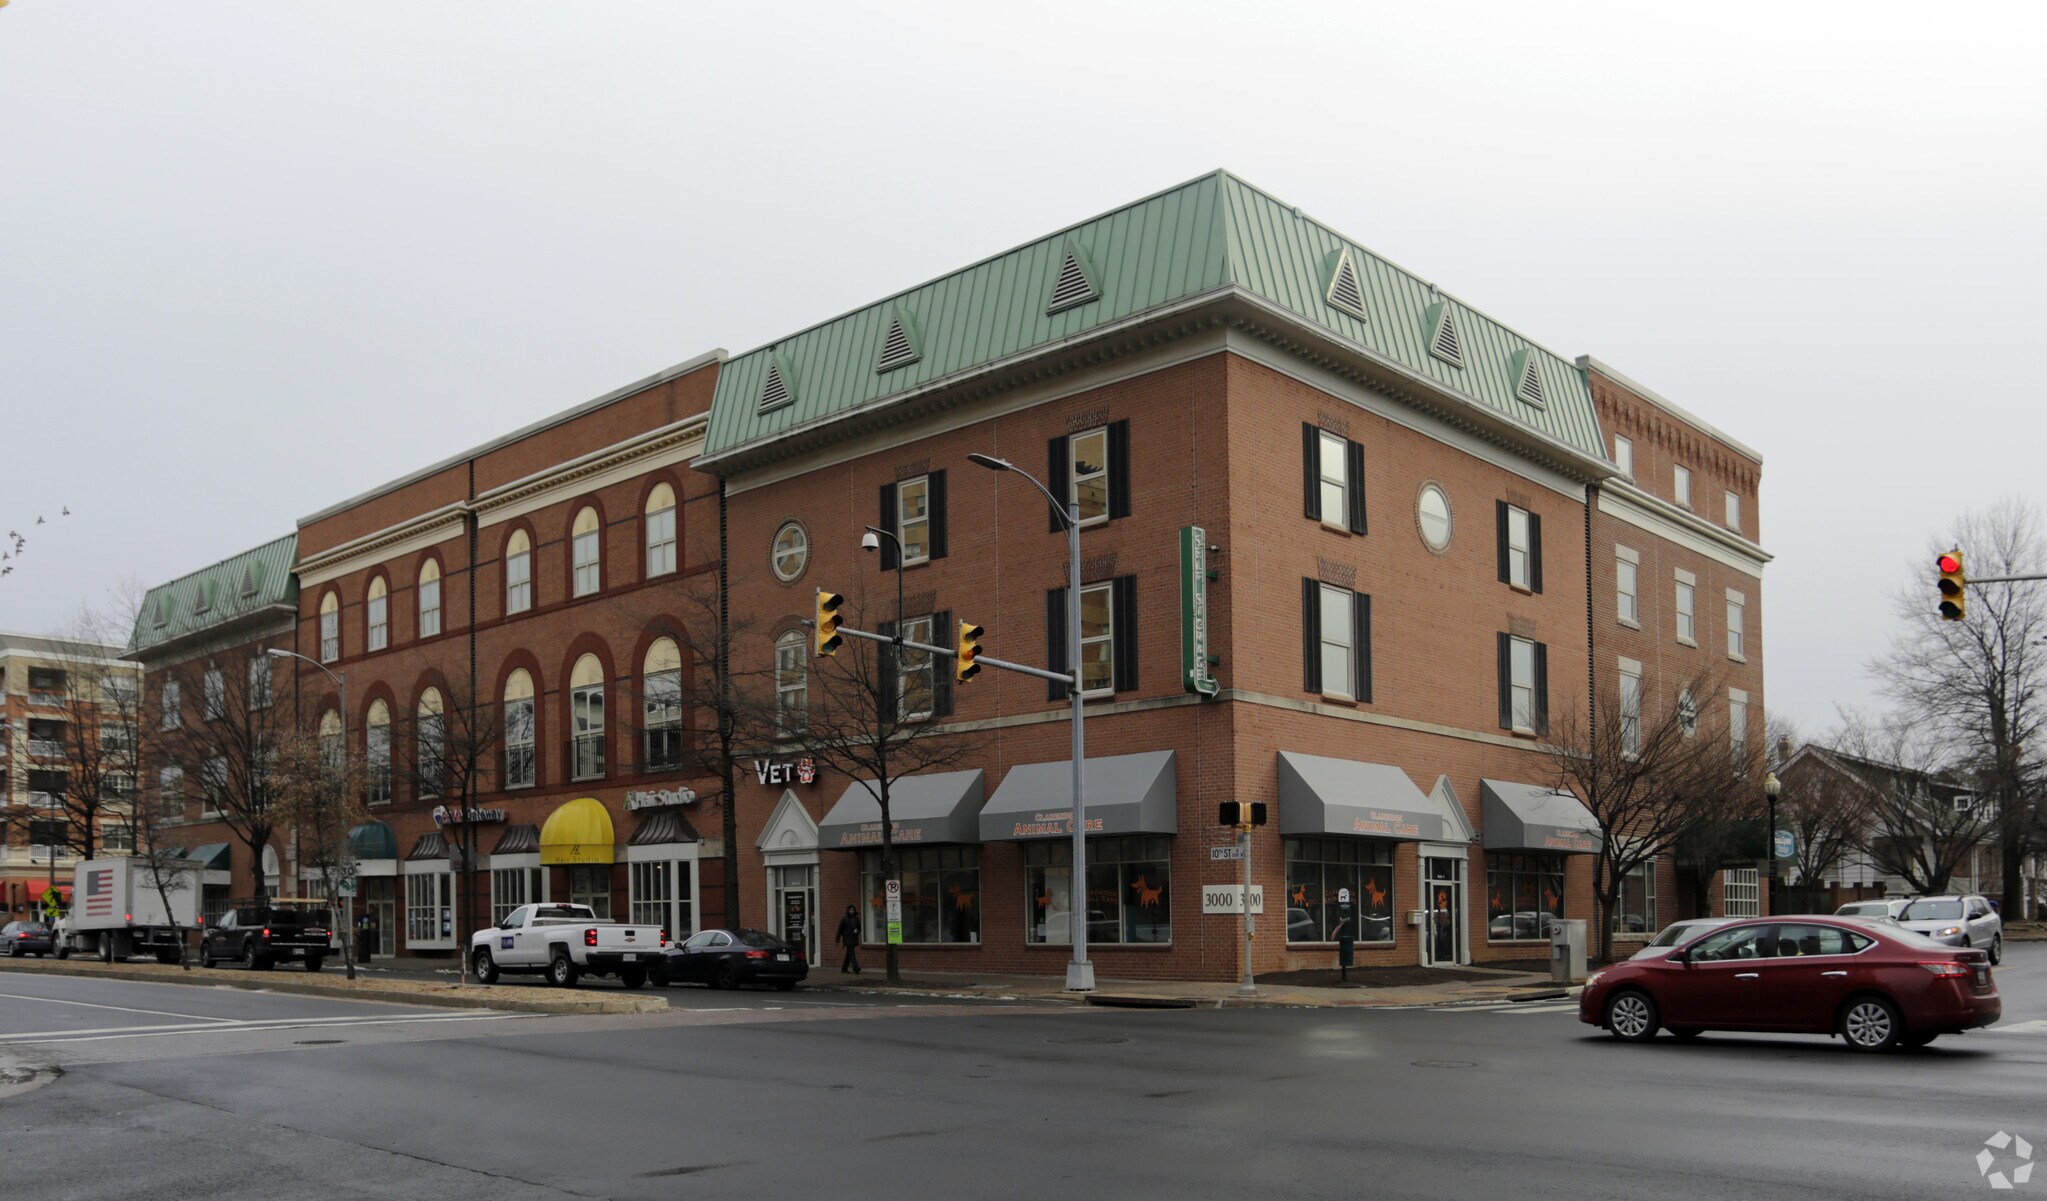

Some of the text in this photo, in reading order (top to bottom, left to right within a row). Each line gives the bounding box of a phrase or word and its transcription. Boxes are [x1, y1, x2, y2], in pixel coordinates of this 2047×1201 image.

[753, 759, 794, 784] VET
[1013, 818, 1103, 836] ANIMAL CRE
[1353, 817, 1419, 836] ANIMAL CARE
[841, 831, 884, 845] ANIMAL
[572, 855, 600, 863] Studio
[1224, 848, 1231, 858] ST
[1205, 893, 1233, 907] 3000
[1240, 893, 1261, 907] 300
